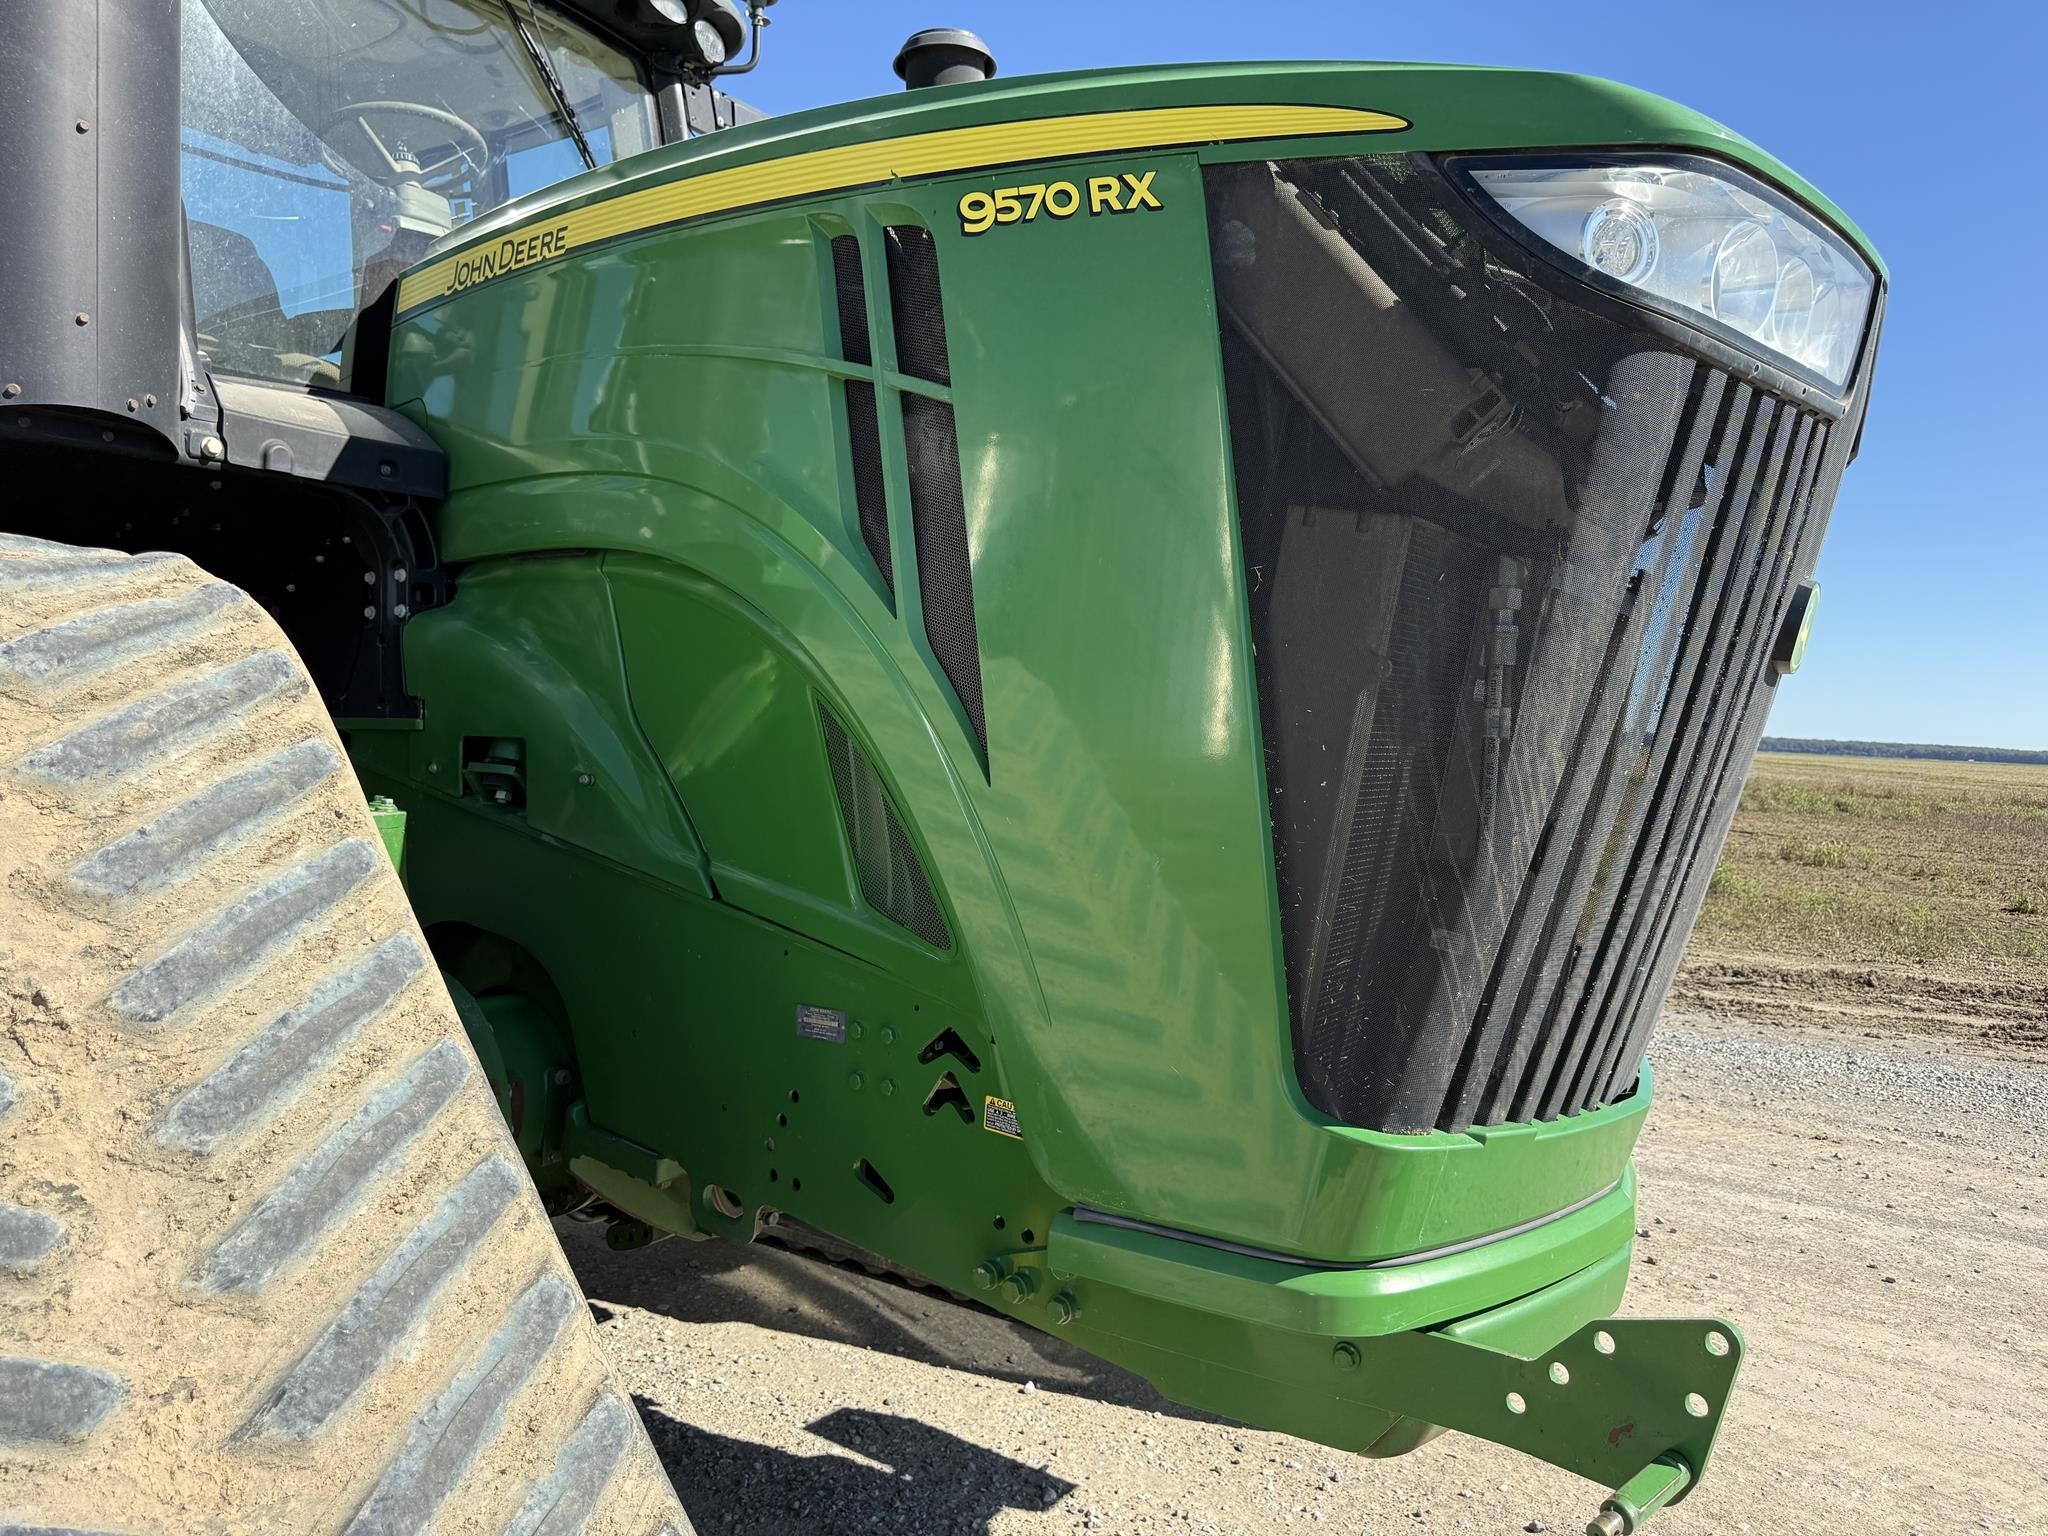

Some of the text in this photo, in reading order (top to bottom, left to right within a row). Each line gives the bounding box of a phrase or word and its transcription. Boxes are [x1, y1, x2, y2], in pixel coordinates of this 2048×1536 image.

[957, 170, 1164, 236] 9570 RX
[447, 226, 569, 291] JOHN DEERE
[996, 1099, 1013, 1110] CAU
